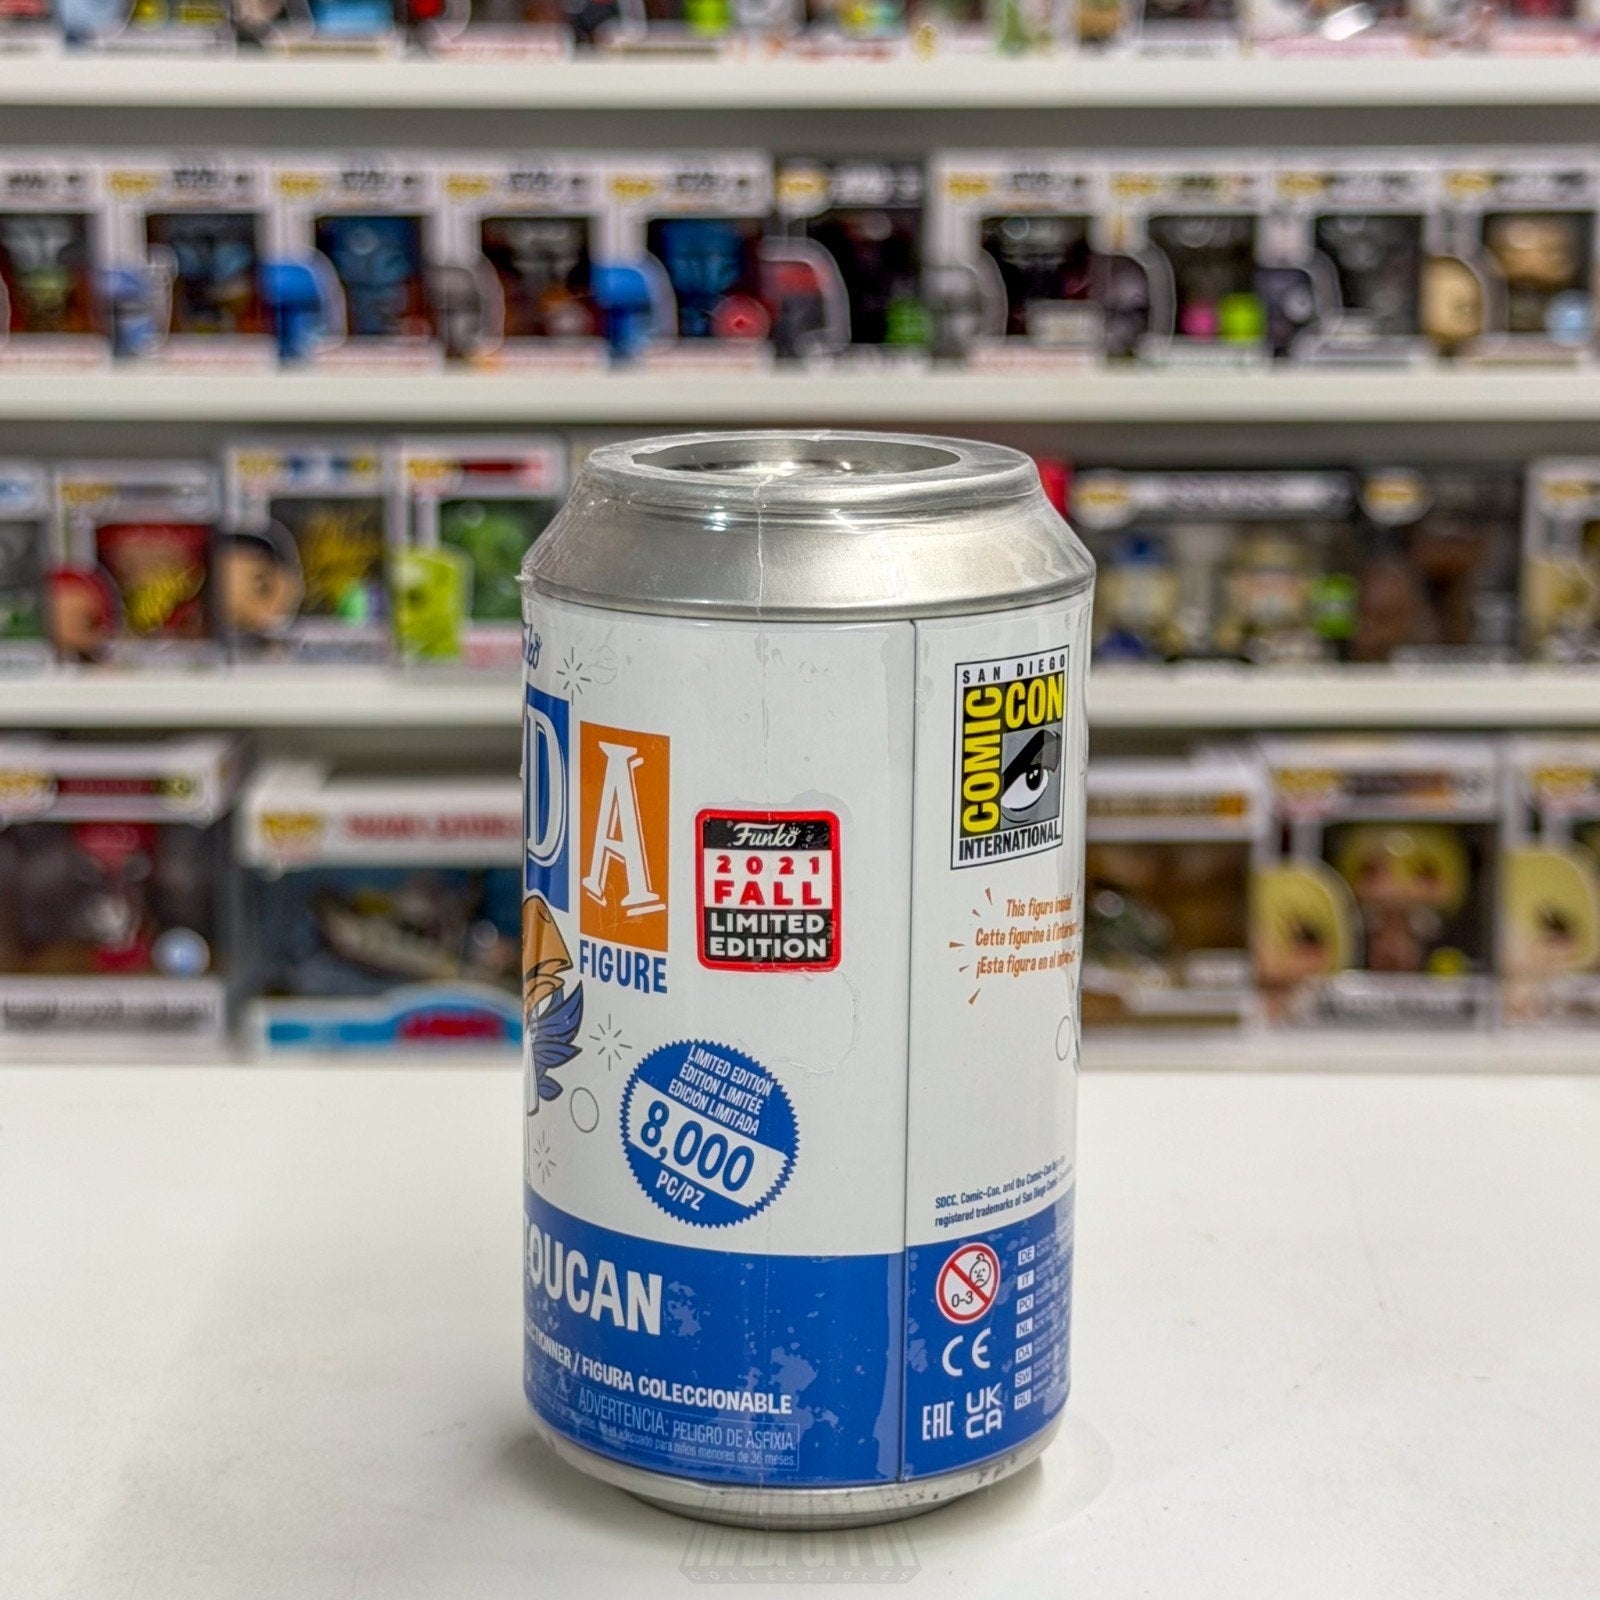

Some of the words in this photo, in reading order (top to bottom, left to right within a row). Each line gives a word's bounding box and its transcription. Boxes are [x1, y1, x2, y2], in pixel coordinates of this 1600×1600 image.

[962, 666, 1001, 684] SAN
[1016, 653, 1066, 677] DIEGO
[1005, 673, 1064, 729] CON
[962, 686, 1003, 833] COMIC
[526, 703, 666, 909] DA
[732, 822, 798, 847] Funko
[716, 855, 820, 875] 2021
[713, 880, 822, 906] FALL
[710, 912, 825, 934] LIMITED
[1006, 898, 1026, 917] This
[1028, 897, 1054, 921] figure
[709, 936, 827, 958] EDITION
[975, 928, 1006, 946] Cette
[1008, 926, 1045, 950] figurine
[580, 939, 667, 994] FIGURE
[1006, 954, 1036, 978] figura
[687, 1044, 731, 1078] LIMITED
[732, 1066, 774, 1097] EDITION
[679, 1061, 721, 1094] ÉDITION
[719, 1082, 763, 1115] LIMITÉE
[668, 1079, 707, 1112] EDICIÓN
[708, 1098, 760, 1136] LIMITADA
[640, 1100, 755, 1192] 8,000
[656, 1170, 705, 1211] PC/PZ
[1002, 1179, 1014, 1193] and
[935, 1208, 974, 1228] registered
[976, 1198, 1013, 1218] trademarks
[1020, 1250, 1032, 1263] DE
[951, 1290, 974, 1308] 0-3
[1019, 1322, 1031, 1334] NL
[942, 1327, 991, 1376] CE
[1017, 1346, 1030, 1359] DA
[582, 1356, 634, 1392] FIGURA
[639, 1375, 792, 1415] COLECCIONABLE
[1017, 1370, 1031, 1384] SW
[966, 1382, 1002, 1414] UK
[1016, 1393, 1028, 1405] RU
[579, 1387, 669, 1436] ADVERTENCIA:
[673, 1420, 722, 1445] PELIGRO
[727, 1430, 743, 1448] DE
[965, 1408, 1002, 1439] CA
[655, 1439, 672, 1453] para
[699, 1447, 735, 1463] menores
[738, 1450, 748, 1463] de
[750, 1451, 763, 1464] 36
